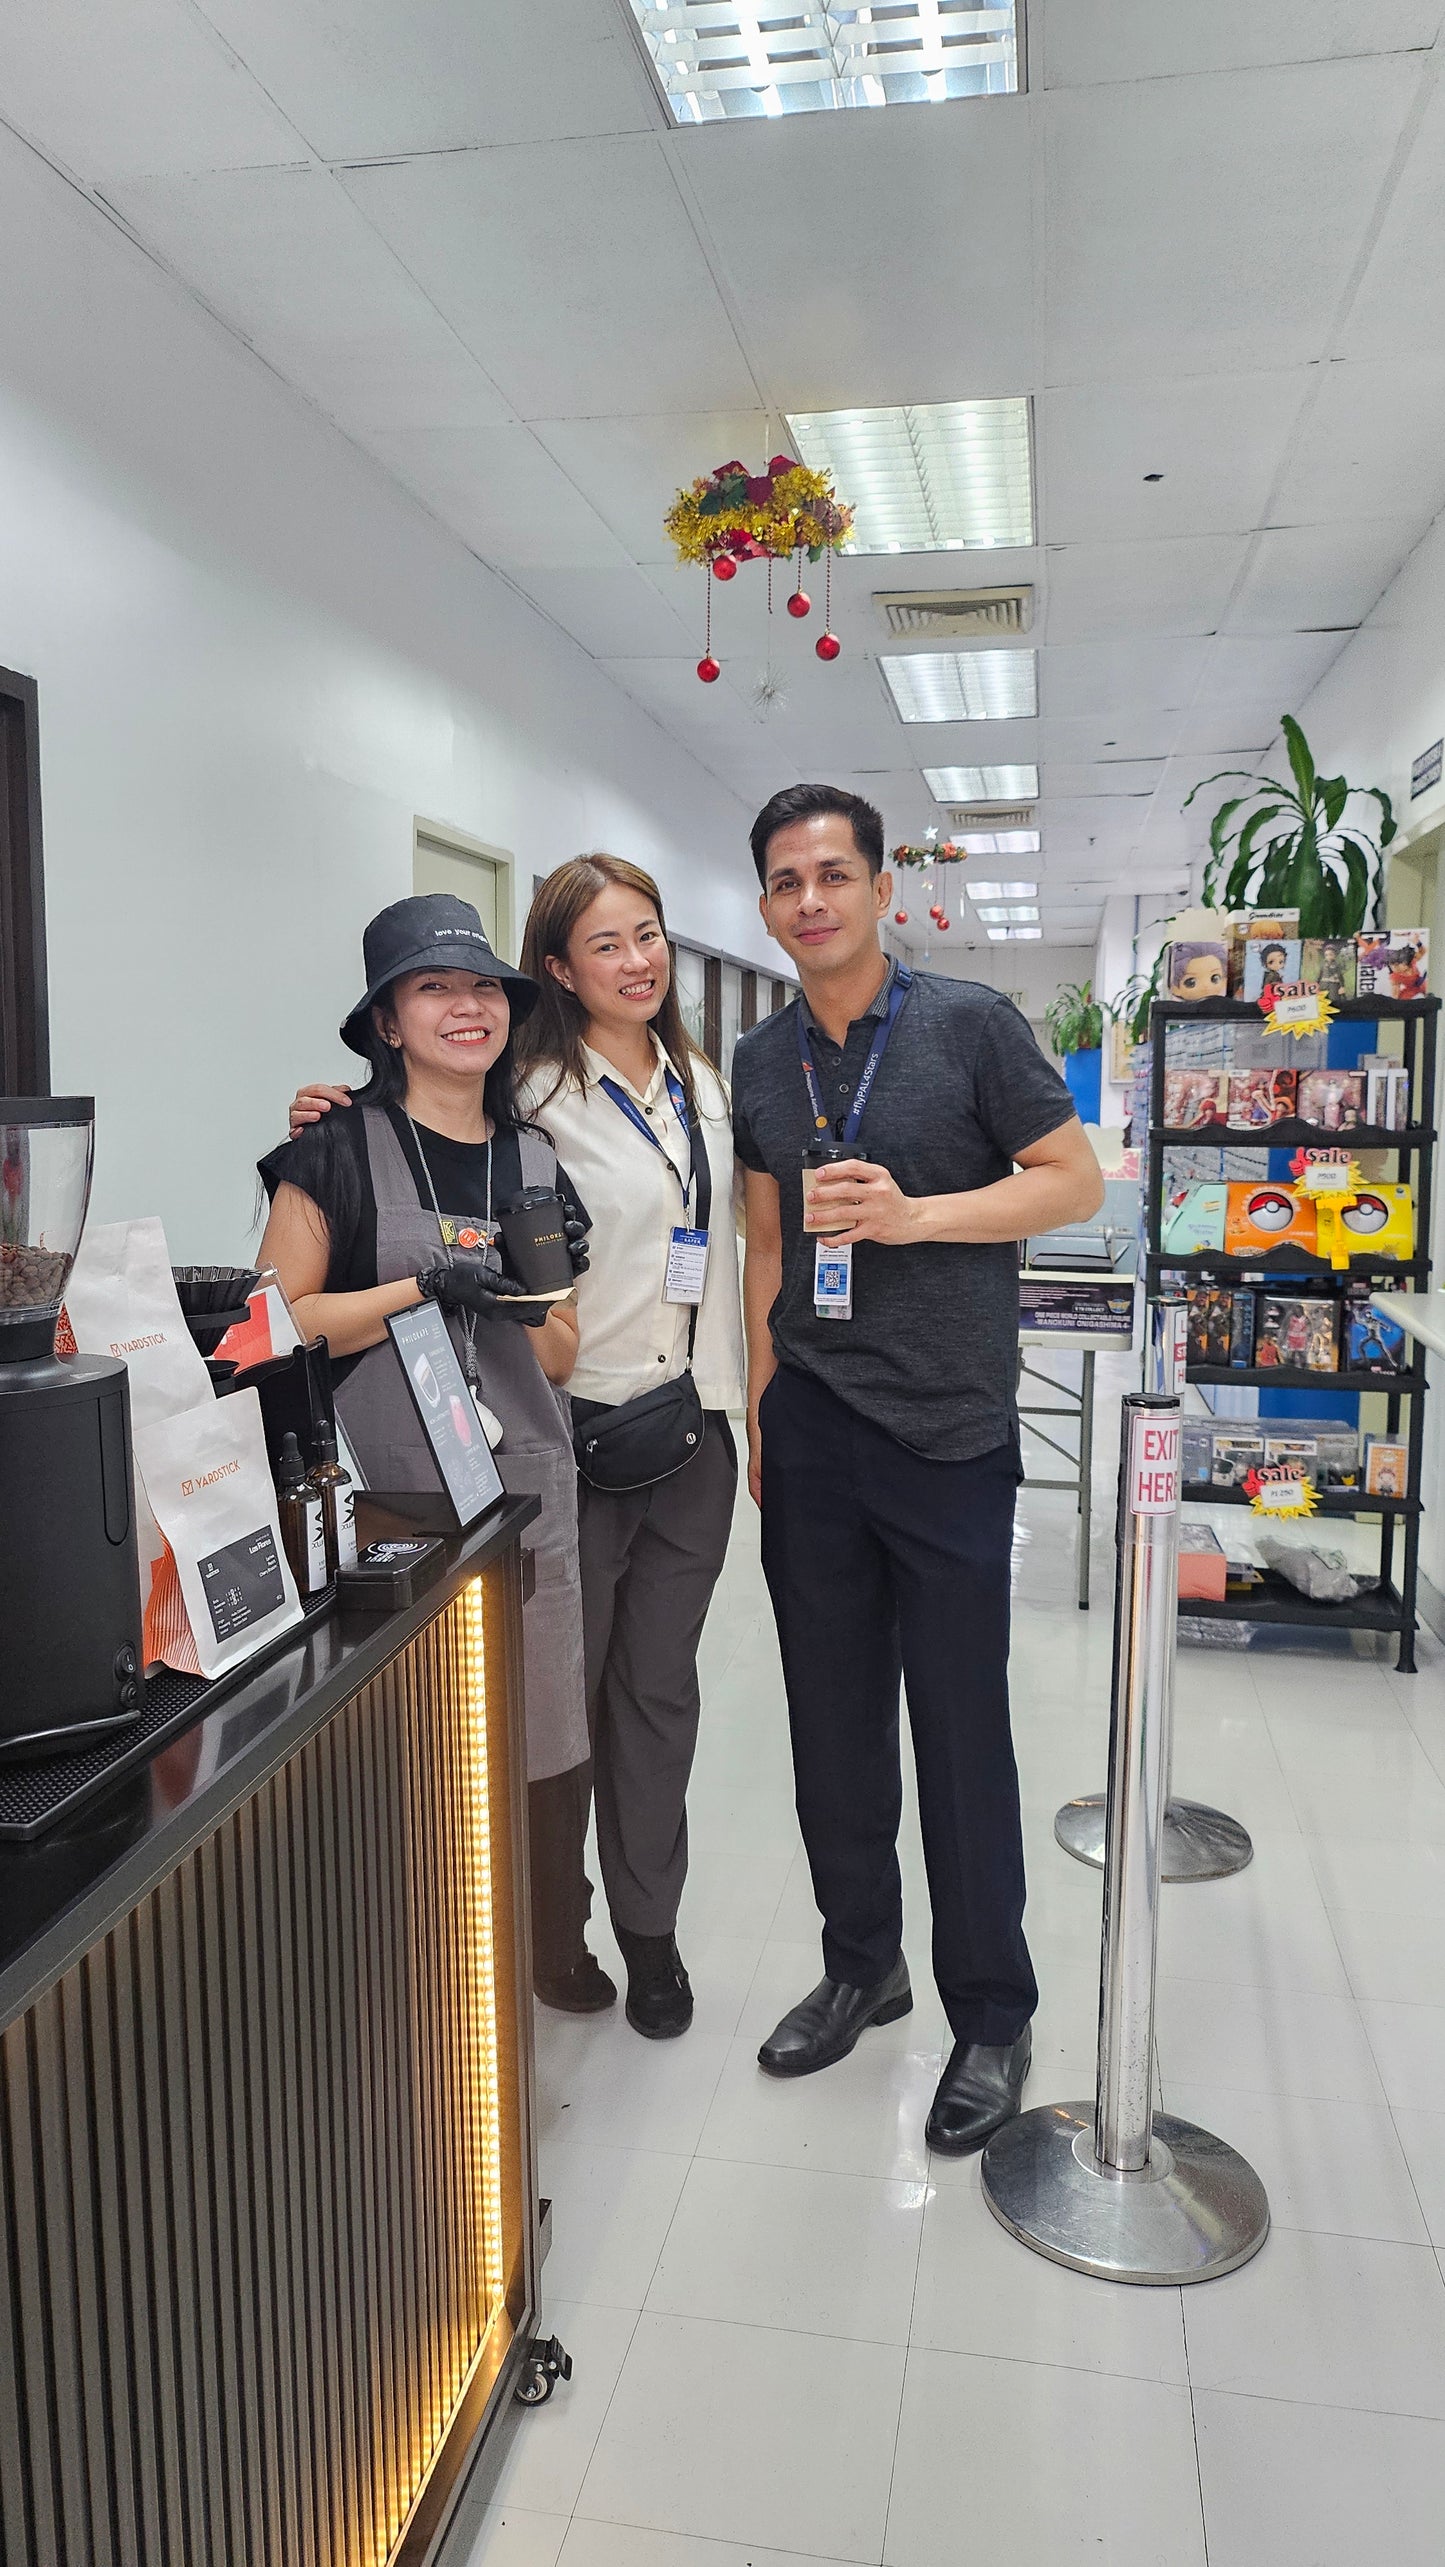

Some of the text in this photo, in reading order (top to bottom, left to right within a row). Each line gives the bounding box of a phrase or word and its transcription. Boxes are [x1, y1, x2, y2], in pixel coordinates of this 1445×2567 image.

[434, 929, 452, 937] love
[454, 928, 471, 936] your
[852, 1053, 879, 1116] #flyPAL4Stars
[121, 1332, 167, 1353] YARDSTICK
[1144, 1429, 1179, 1461] EXIT
[195, 1460, 241, 1489] YARDSTICK
[1138, 1471, 1178, 1503] HERE
